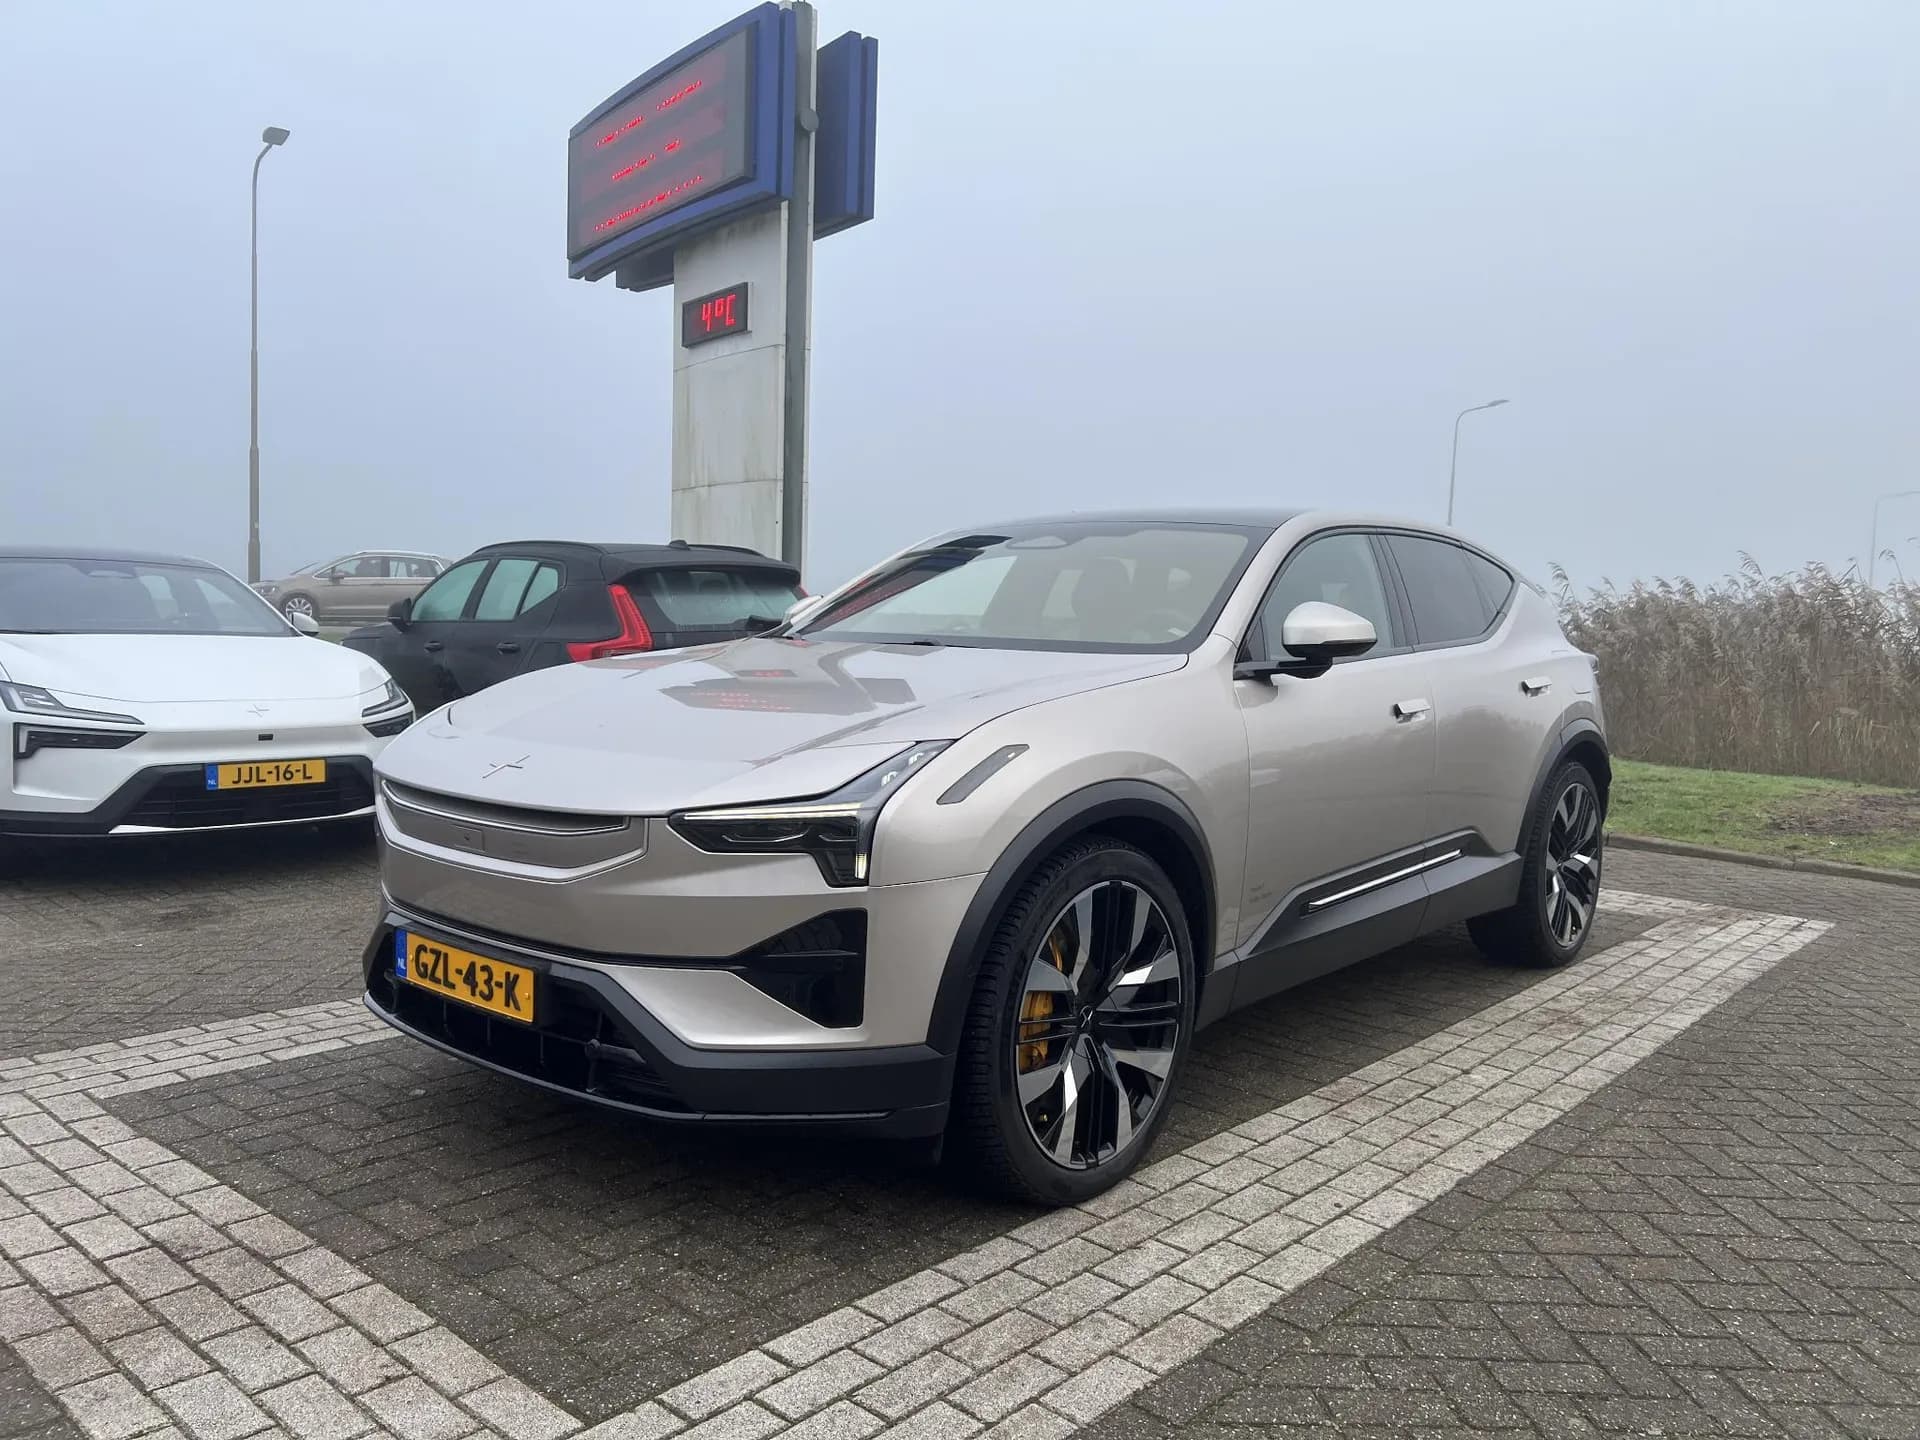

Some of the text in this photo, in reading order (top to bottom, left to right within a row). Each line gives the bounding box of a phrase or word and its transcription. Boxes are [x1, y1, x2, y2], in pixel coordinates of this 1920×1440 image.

[232, 763, 312, 784] JJL-16-L
[397, 957, 406, 969] NL
[414, 944, 521, 1011] GZL-43-K
